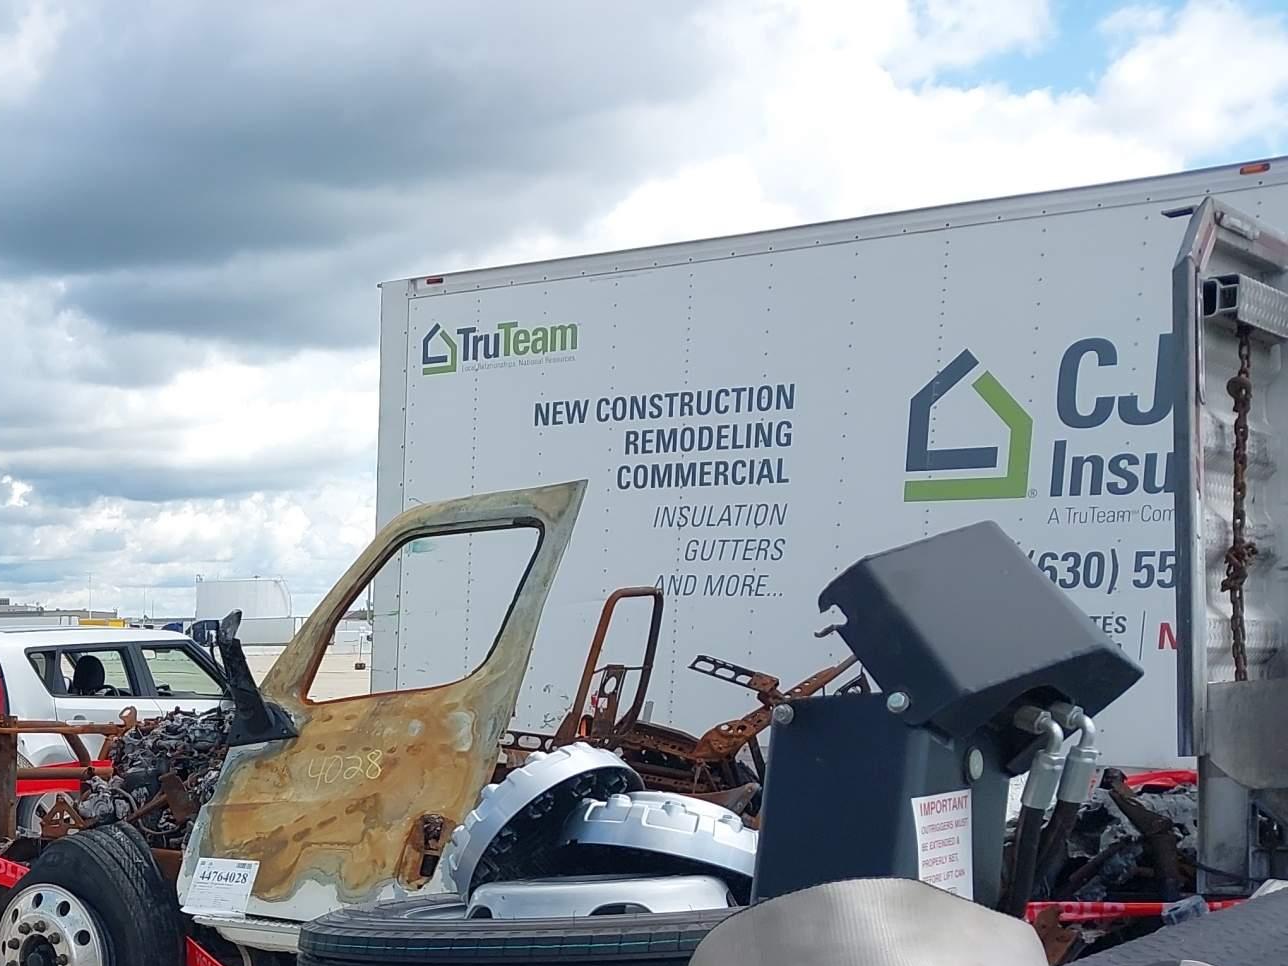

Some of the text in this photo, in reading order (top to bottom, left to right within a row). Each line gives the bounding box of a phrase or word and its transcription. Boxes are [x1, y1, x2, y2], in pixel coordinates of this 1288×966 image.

[457, 322, 578, 361] TruTeam
[1056, 333, 1173, 428] CJ
[534, 383, 796, 427] NEW CONSTRUCTION
[624, 420, 793, 455] REMODELING
[616, 458, 790, 490] COMMERCIAL
[1049, 440, 1175, 498] Insu
[653, 503, 788, 528] INSULATION
[1047, 507, 1060, 525] A
[1065, 506, 1131, 525] TruTeam
[684, 538, 787, 562] GUTTERS
[654, 574, 784, 597] AND MORE...
[308, 749, 384, 790] 4028
[919, 795, 969, 817] IMPORTANT
[199, 870, 249, 884] 44764028
